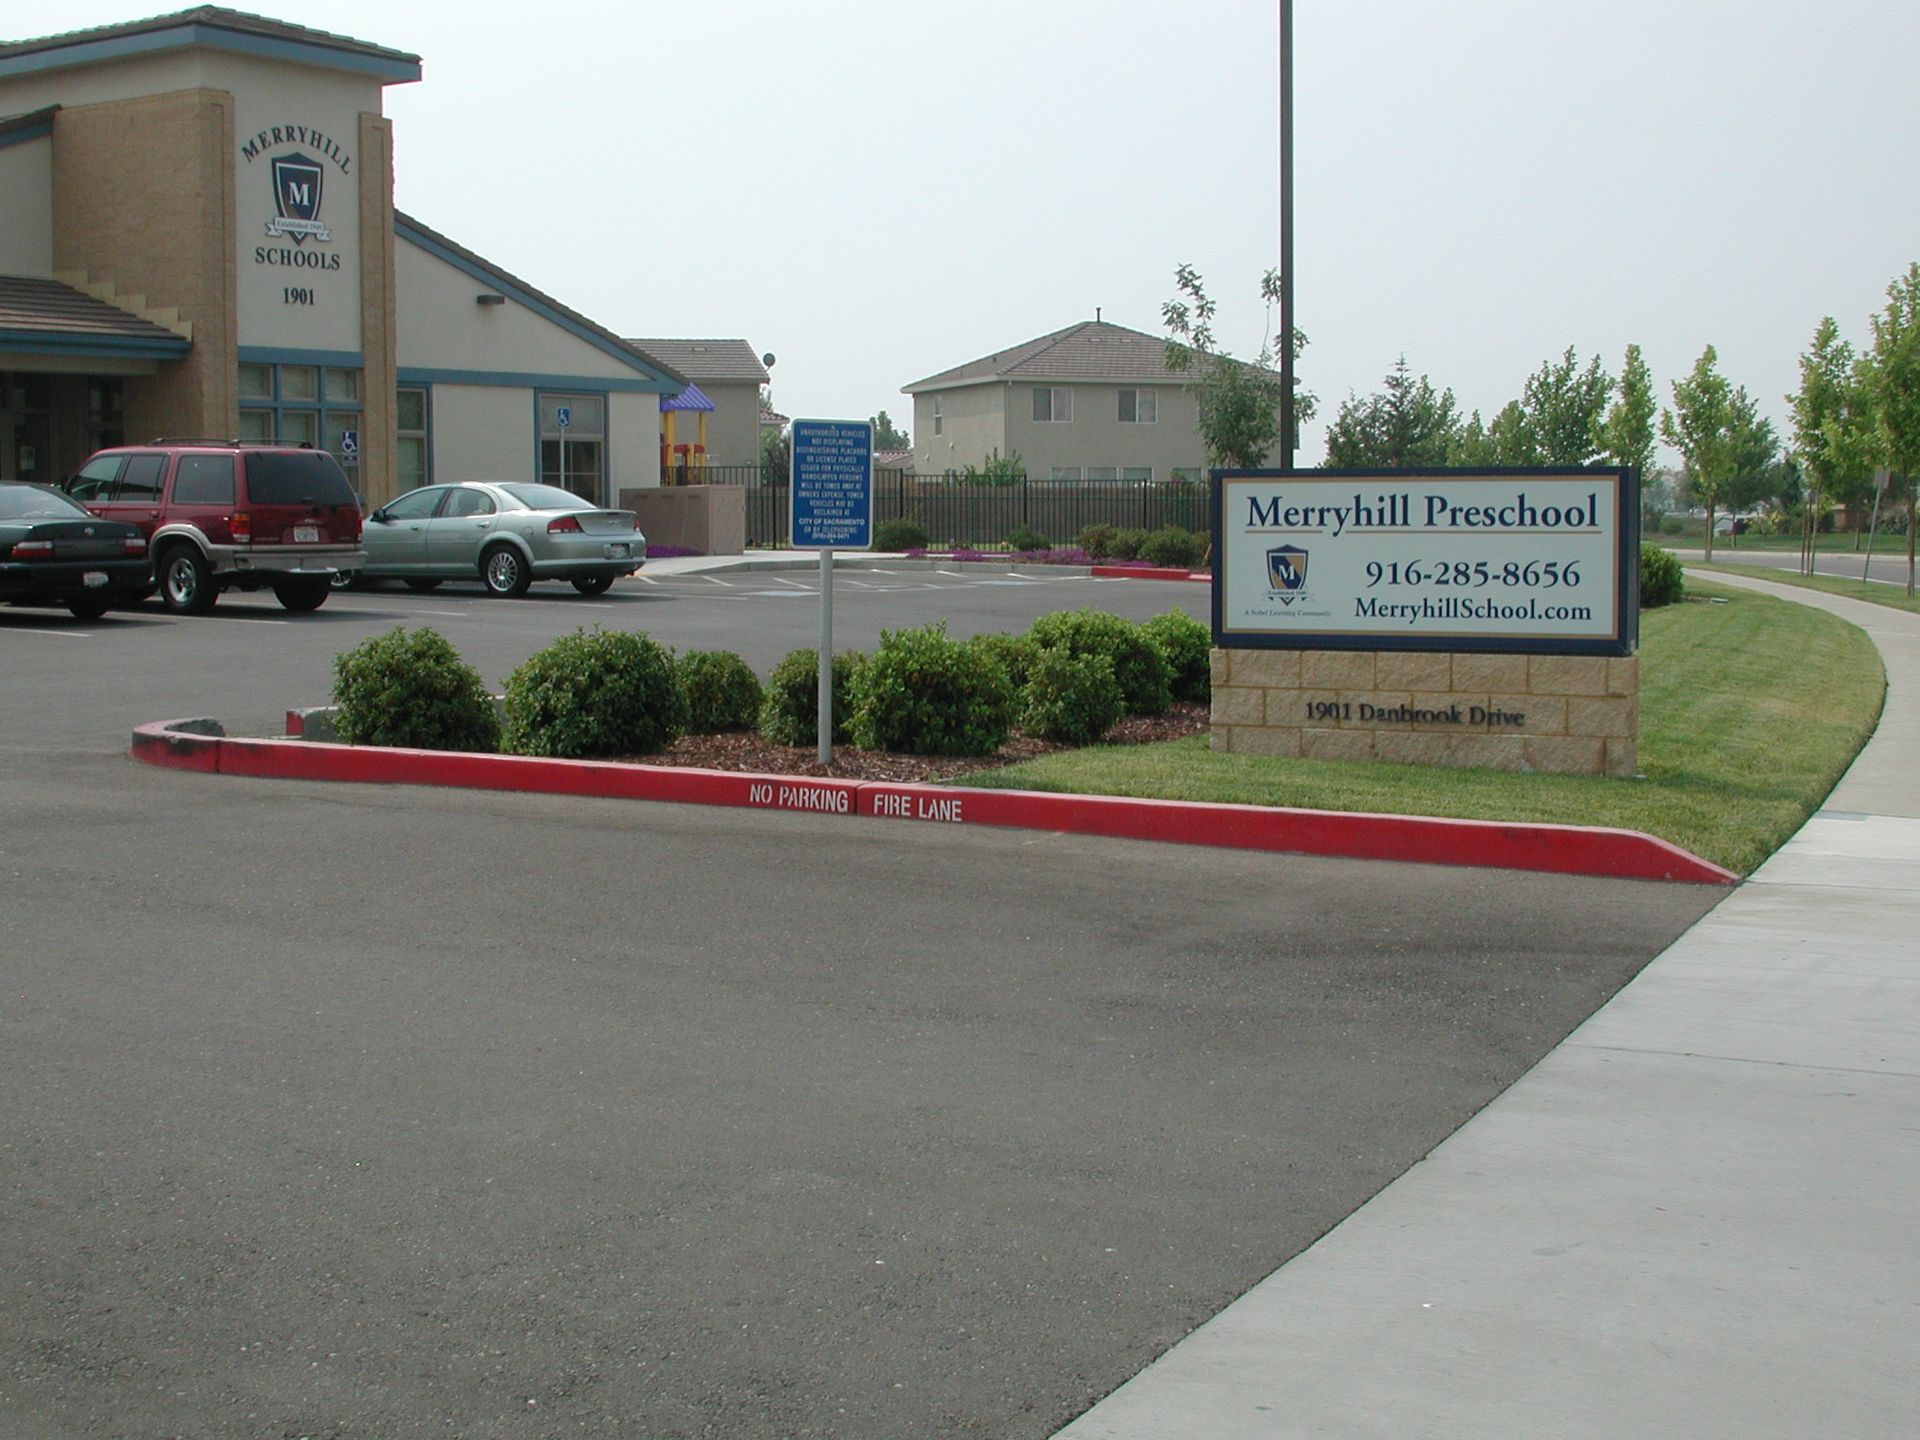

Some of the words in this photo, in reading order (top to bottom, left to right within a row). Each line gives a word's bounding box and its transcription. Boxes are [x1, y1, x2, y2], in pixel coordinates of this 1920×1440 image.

[241, 125, 351, 176] MERRYHILL
[289, 182, 310, 206] M
[255, 246, 340, 270] SCHOOLS
[283, 288, 314, 306] 1901
[1247, 494, 1410, 537] Merryhill
[1424, 493, 1599, 528] Preschool
[1278, 565, 1295, 580] M
[1366, 559, 1581, 588] 916-285-8656
[1355, 597, 1592, 624] MerryhillSchool.com
[1306, 702, 1352, 720] 1901
[1359, 704, 1462, 724] Danbrook
[1468, 706, 1526, 726] Drive
[750, 784, 772, 803] NO
[779, 786, 848, 812] PARKING
[874, 794, 911, 816] FIRE
[918, 798, 962, 822] LANE
